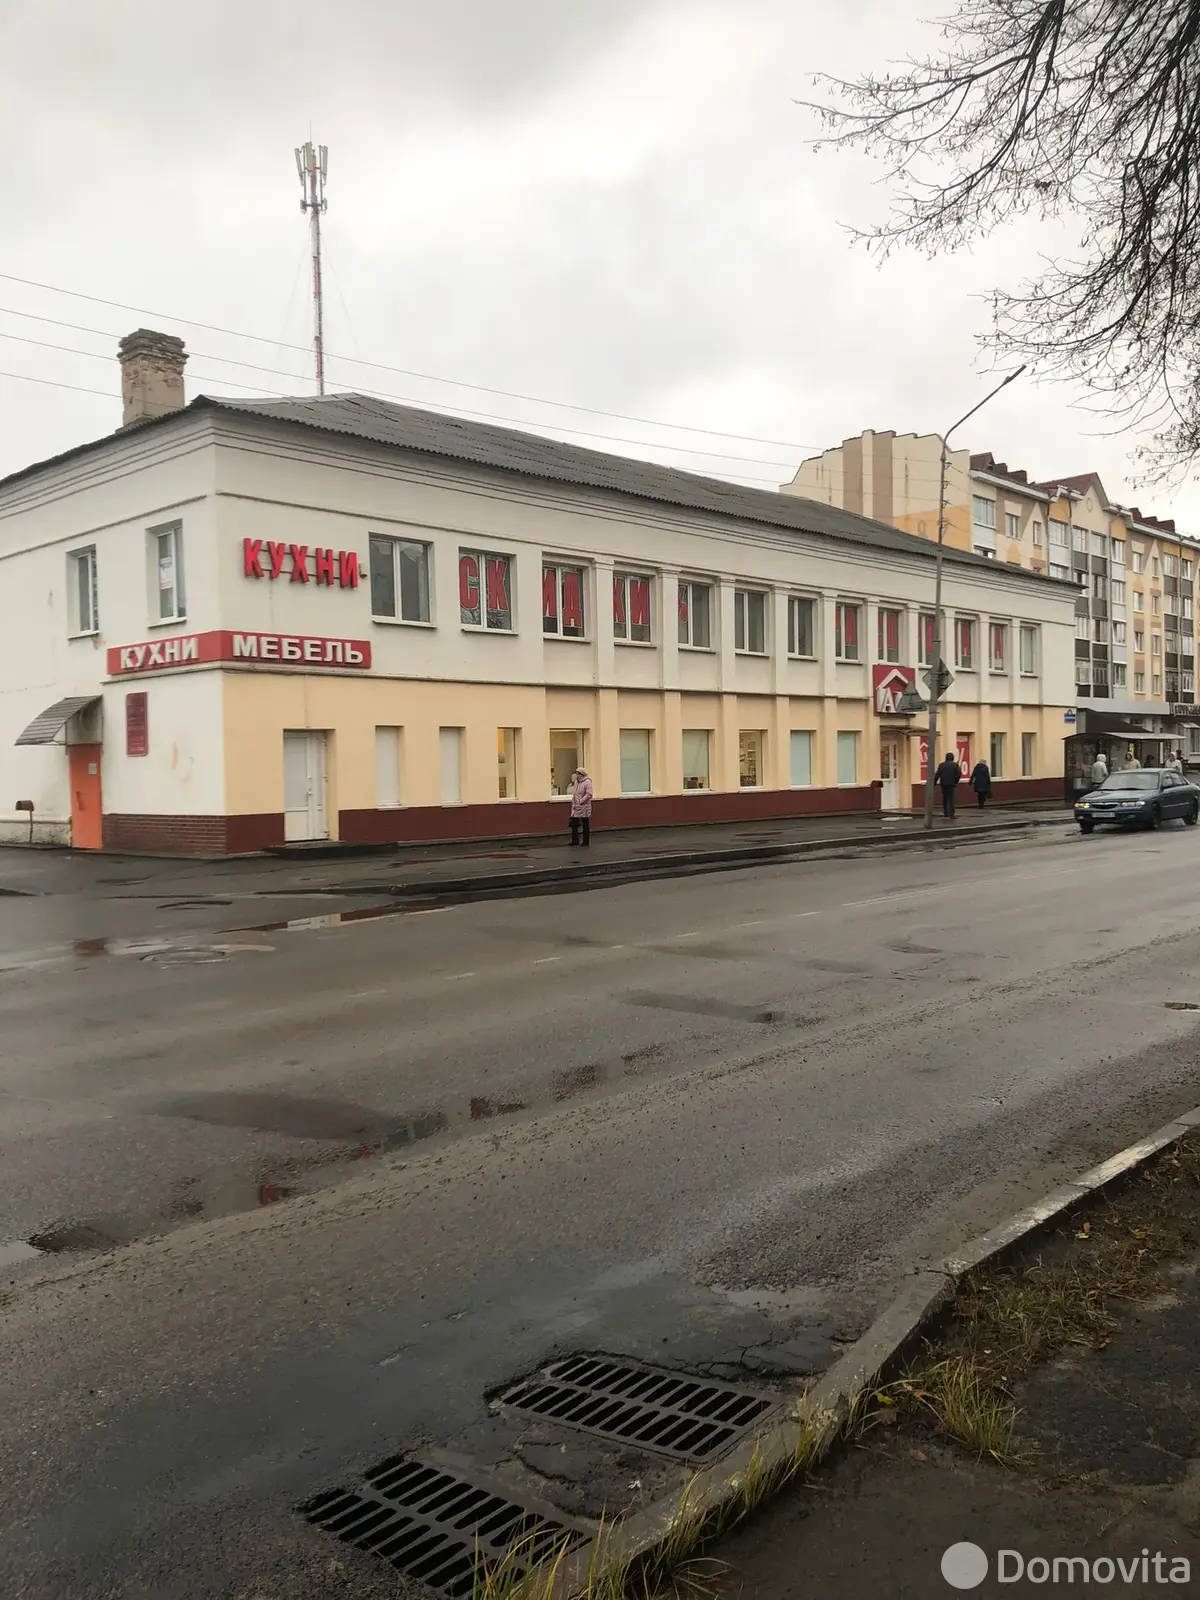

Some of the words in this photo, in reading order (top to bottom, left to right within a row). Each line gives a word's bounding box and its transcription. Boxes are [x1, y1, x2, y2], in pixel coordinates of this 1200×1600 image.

[243, 537, 358, 589] КУХНИ
[120, 636, 199, 670] КУХНИ
[232, 634, 363, 664] МЕБЕЛЬ
